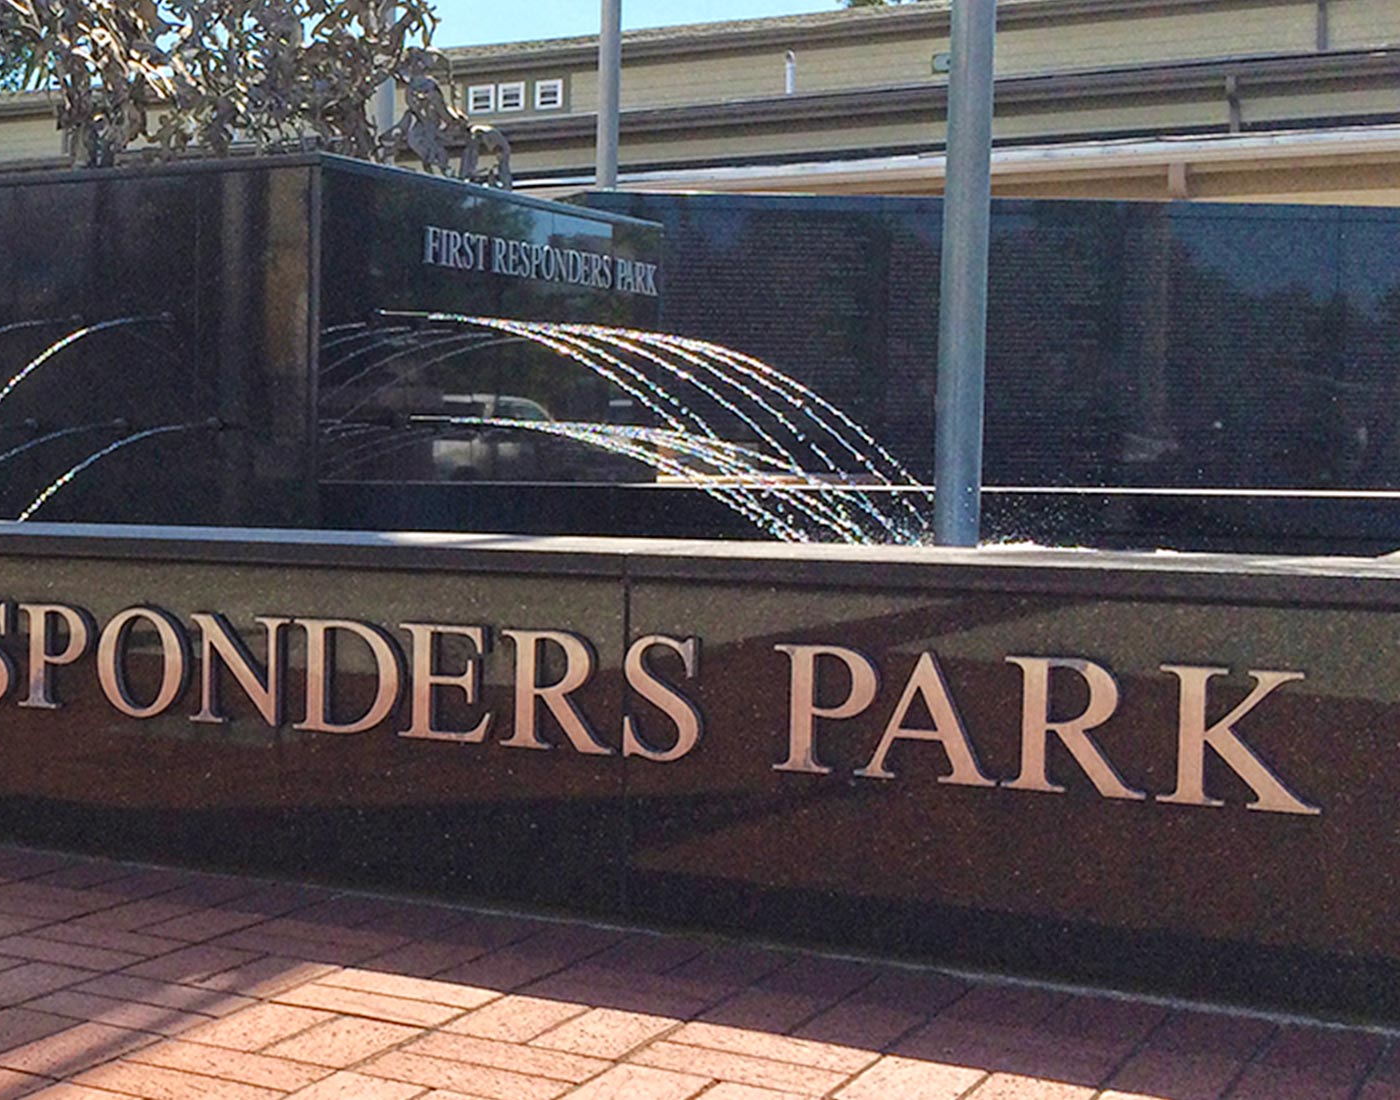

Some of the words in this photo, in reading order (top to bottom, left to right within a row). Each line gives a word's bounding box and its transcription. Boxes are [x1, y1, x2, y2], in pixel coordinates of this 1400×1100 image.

[423, 226, 490, 272] FIRST
[491, 237, 613, 290] RESPONDERS
[615, 258, 659, 297] PARK
[773, 642, 1322, 817] PARK
